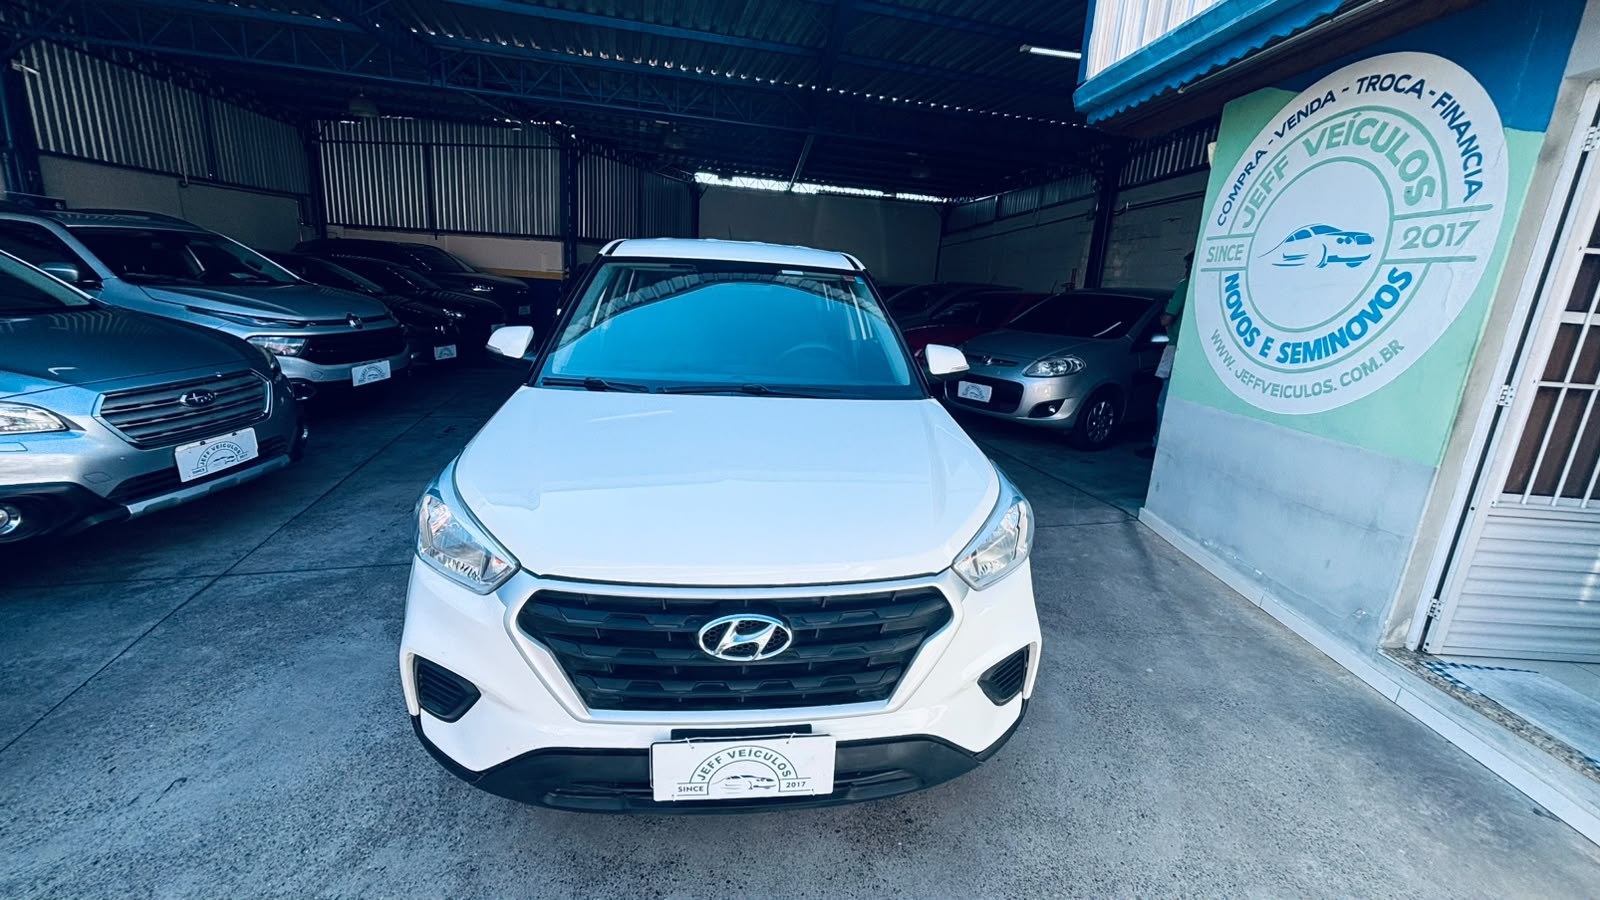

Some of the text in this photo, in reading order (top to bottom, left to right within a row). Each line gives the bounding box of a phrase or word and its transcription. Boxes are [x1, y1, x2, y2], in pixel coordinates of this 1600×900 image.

[1217, 149, 1268, 226] COMPRA
[1274, 90, 1336, 139] VENDA
[1356, 73, 1426, 99] TROCA
[1431, 91, 1484, 203] FINANCIA
[1242, 111, 1437, 229] JEFF VEÍCULOS
[1207, 220, 1481, 263] SINCE 2017
[1224, 266, 1413, 364] NOVOS E SEMINOVOS
[677, 781, 806, 793] SINCE 2017
[697, 756, 722, 781] JEFF
